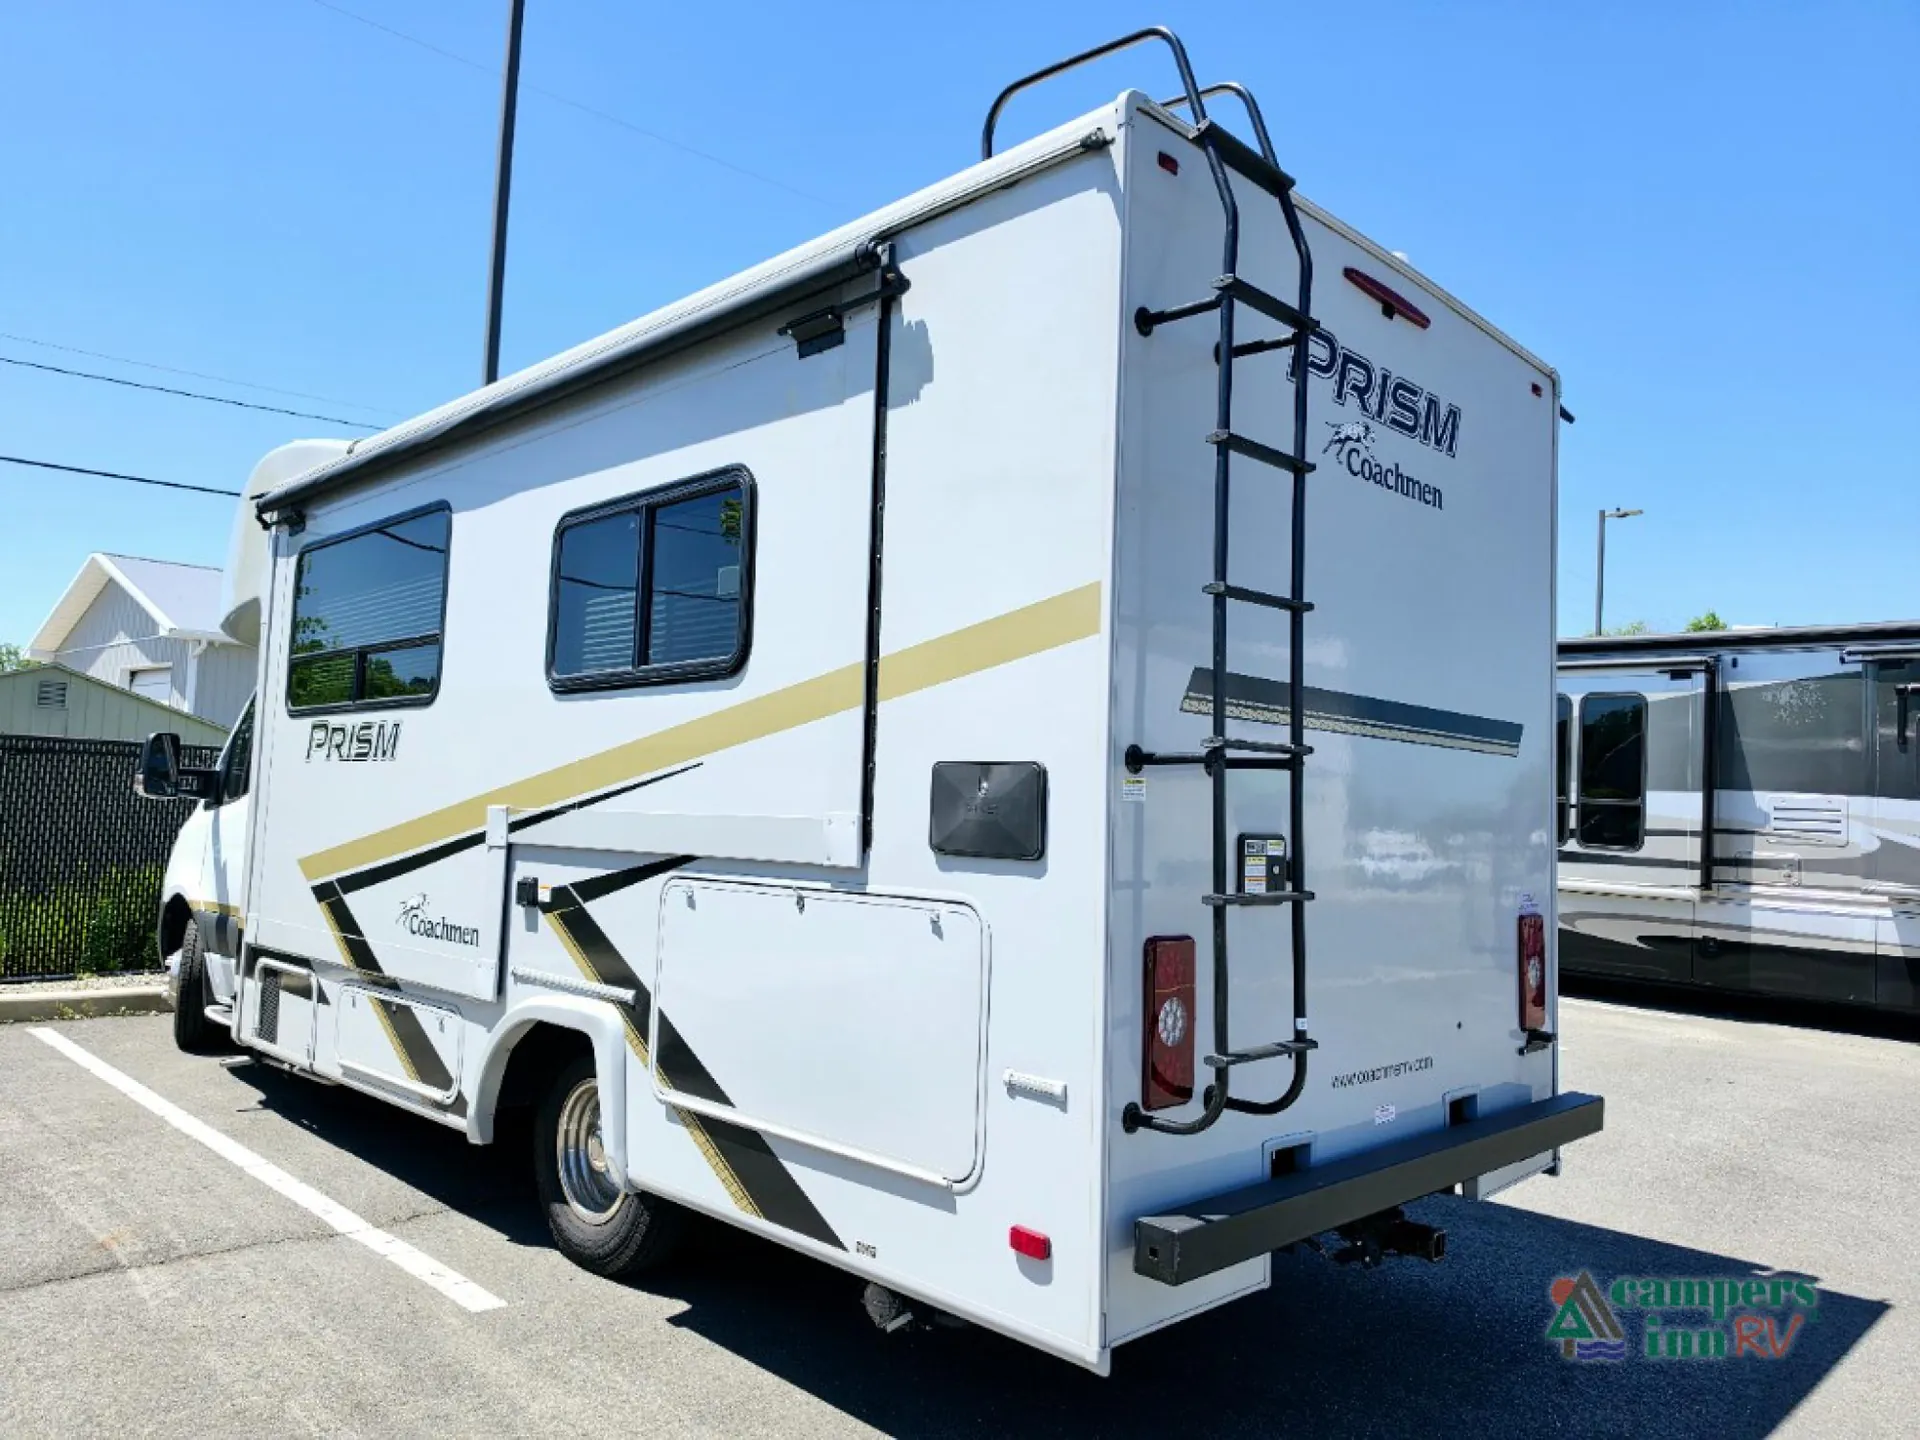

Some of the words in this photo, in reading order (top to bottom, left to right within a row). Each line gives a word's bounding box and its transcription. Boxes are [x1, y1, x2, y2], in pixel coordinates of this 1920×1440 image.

[1286, 327, 1462, 459] PRISM
[1346, 447, 1443, 510] Coachmen
[305, 720, 401, 763] PRISM
[409, 914, 480, 947] Coachmen
